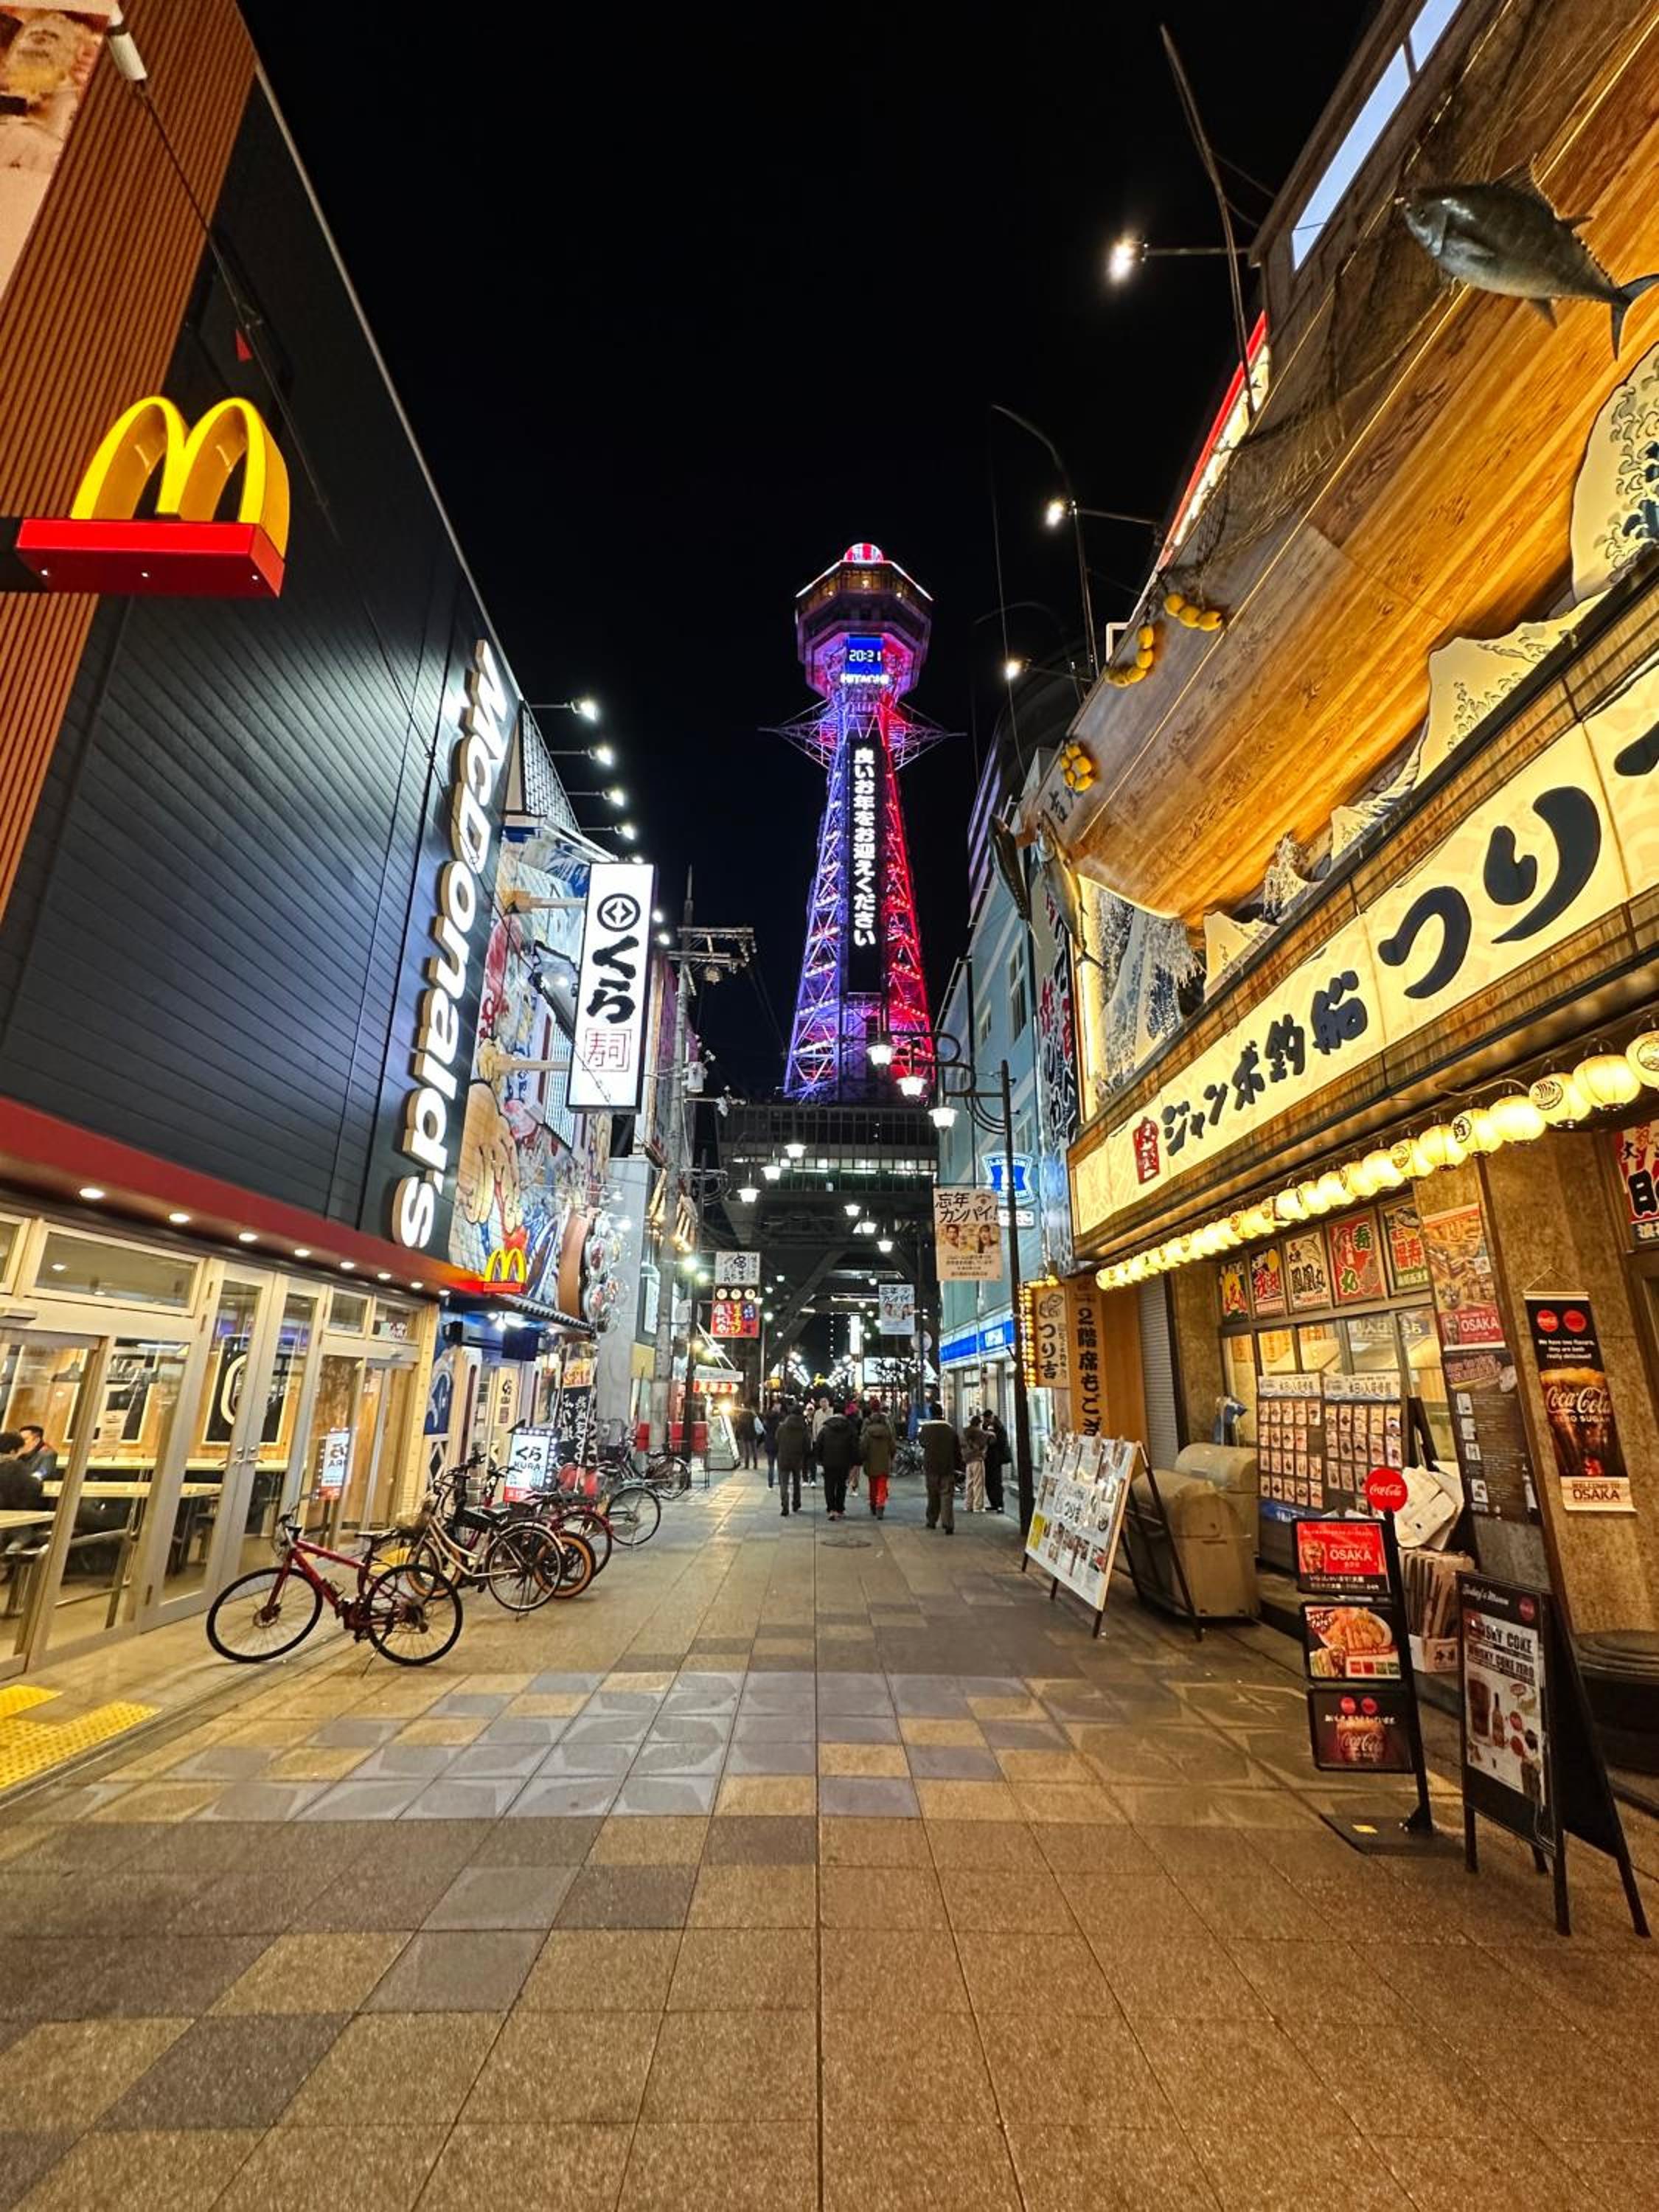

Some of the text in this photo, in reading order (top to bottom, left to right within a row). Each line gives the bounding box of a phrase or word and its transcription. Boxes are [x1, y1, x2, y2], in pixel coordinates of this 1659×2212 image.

[849, 650, 881, 662] 20:21
[840, 673, 889, 684] HITACHI
[853, 747, 876, 947] 良いお年をお迎えください
[393, 639, 510, 1250] McDonald's
[586, 935, 639, 1024] くら
[1161, 970, 1368, 1157] ジャンボ釣船
[935, 1192, 970, 1208] 忘年
[939, 1206, 998, 1223] カンパイ!
[1461, 1317, 1500, 1333] OSAKA
[1038, 1324, 1059, 1380] つり吉
[1547, 1385, 1613, 1414] Coca-Cola
[515, 1446, 542, 1461] くら
[514, 1461, 540, 1471] KURA
[1369, 1483, 1402, 1497] Coca-Cola
[1572, 1488, 1621, 1501] OSAKA
[1329, 1549, 1372, 1561] OSAKA
[1506, 1631, 1532, 1654] COKE
